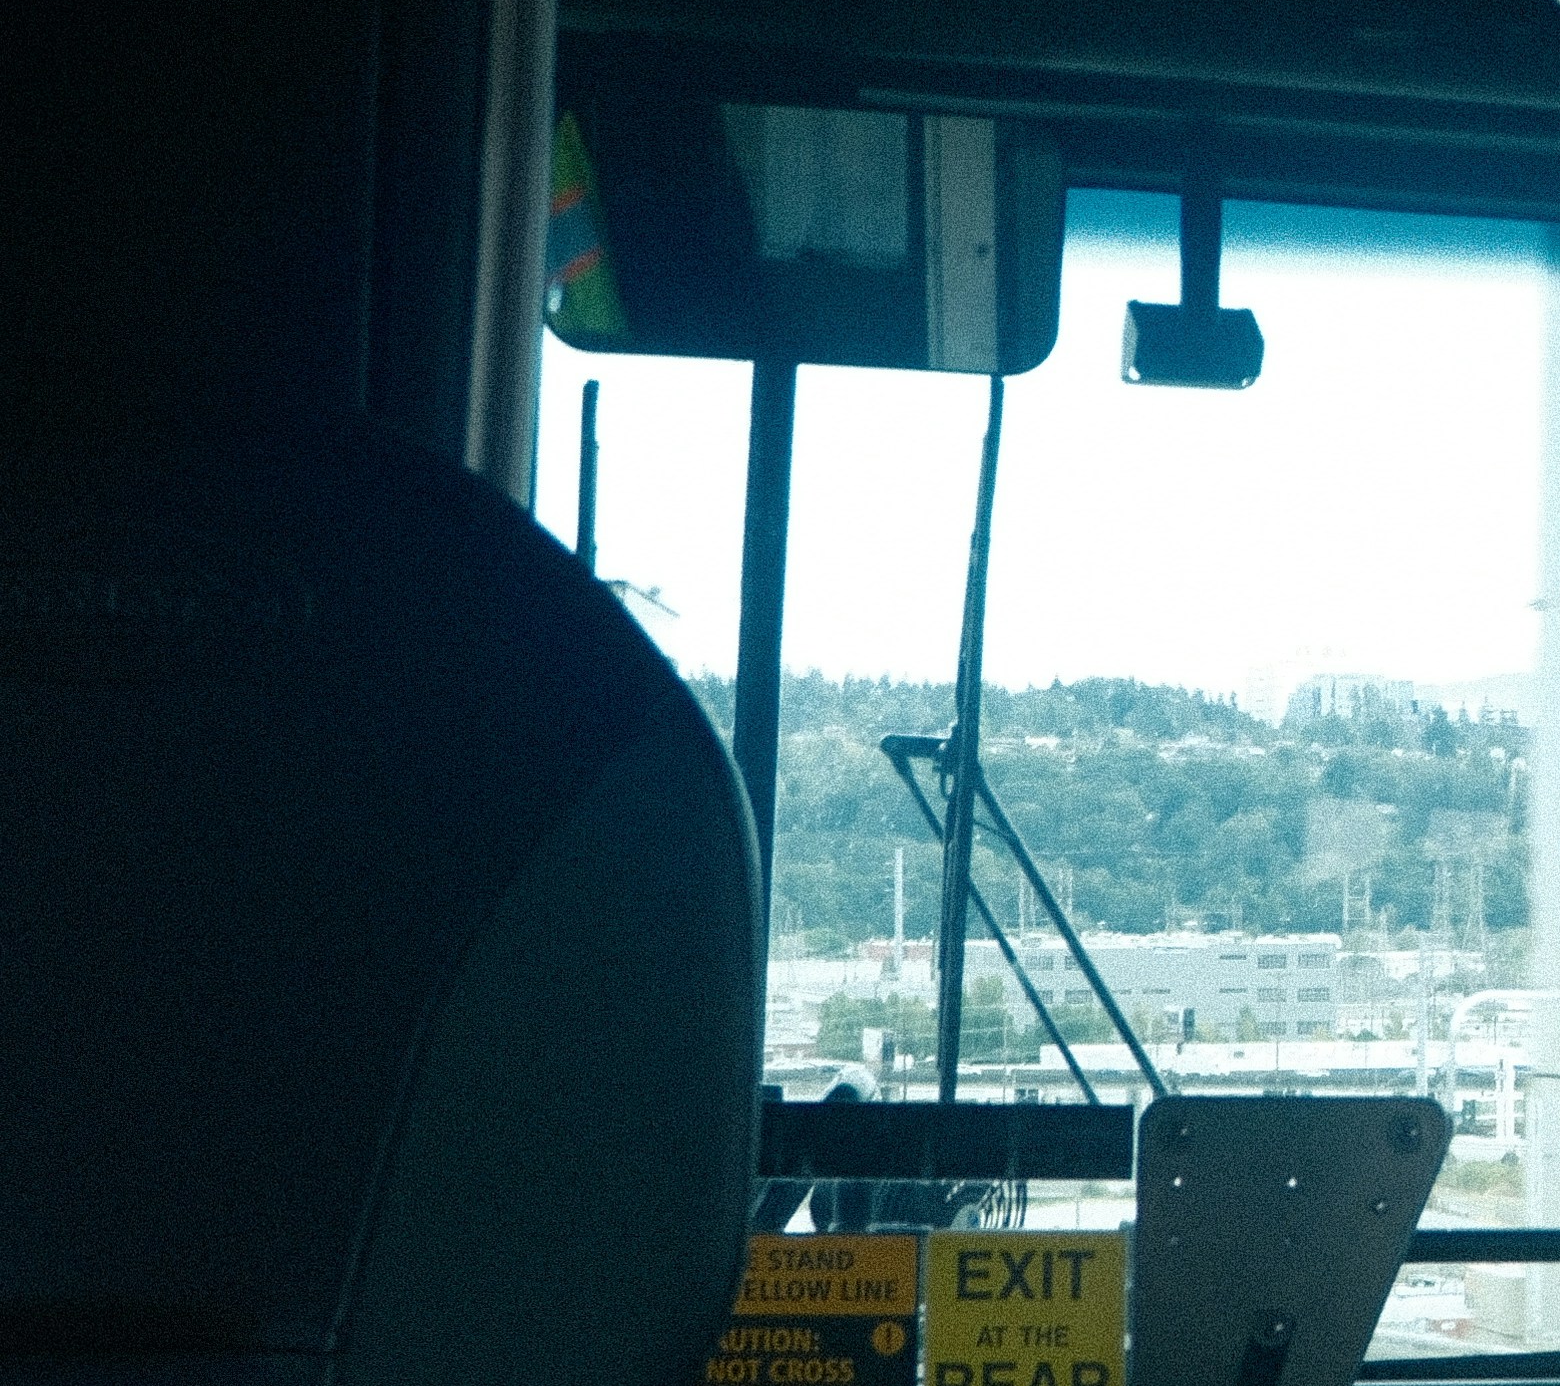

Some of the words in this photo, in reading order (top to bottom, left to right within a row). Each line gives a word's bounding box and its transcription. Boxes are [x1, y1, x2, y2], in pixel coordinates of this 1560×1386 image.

[768, 1248, 855, 1272] STAND
[956, 1250, 1096, 1303] EXIT
[742, 1279, 833, 1303] ELLOW
[840, 1280, 900, 1302] LINE
[976, 1324, 1011, 1348] AT
[1019, 1323, 1070, 1348] THE
[705, 1358, 762, 1383] NOT
[768, 1358, 856, 1384] CROSS
